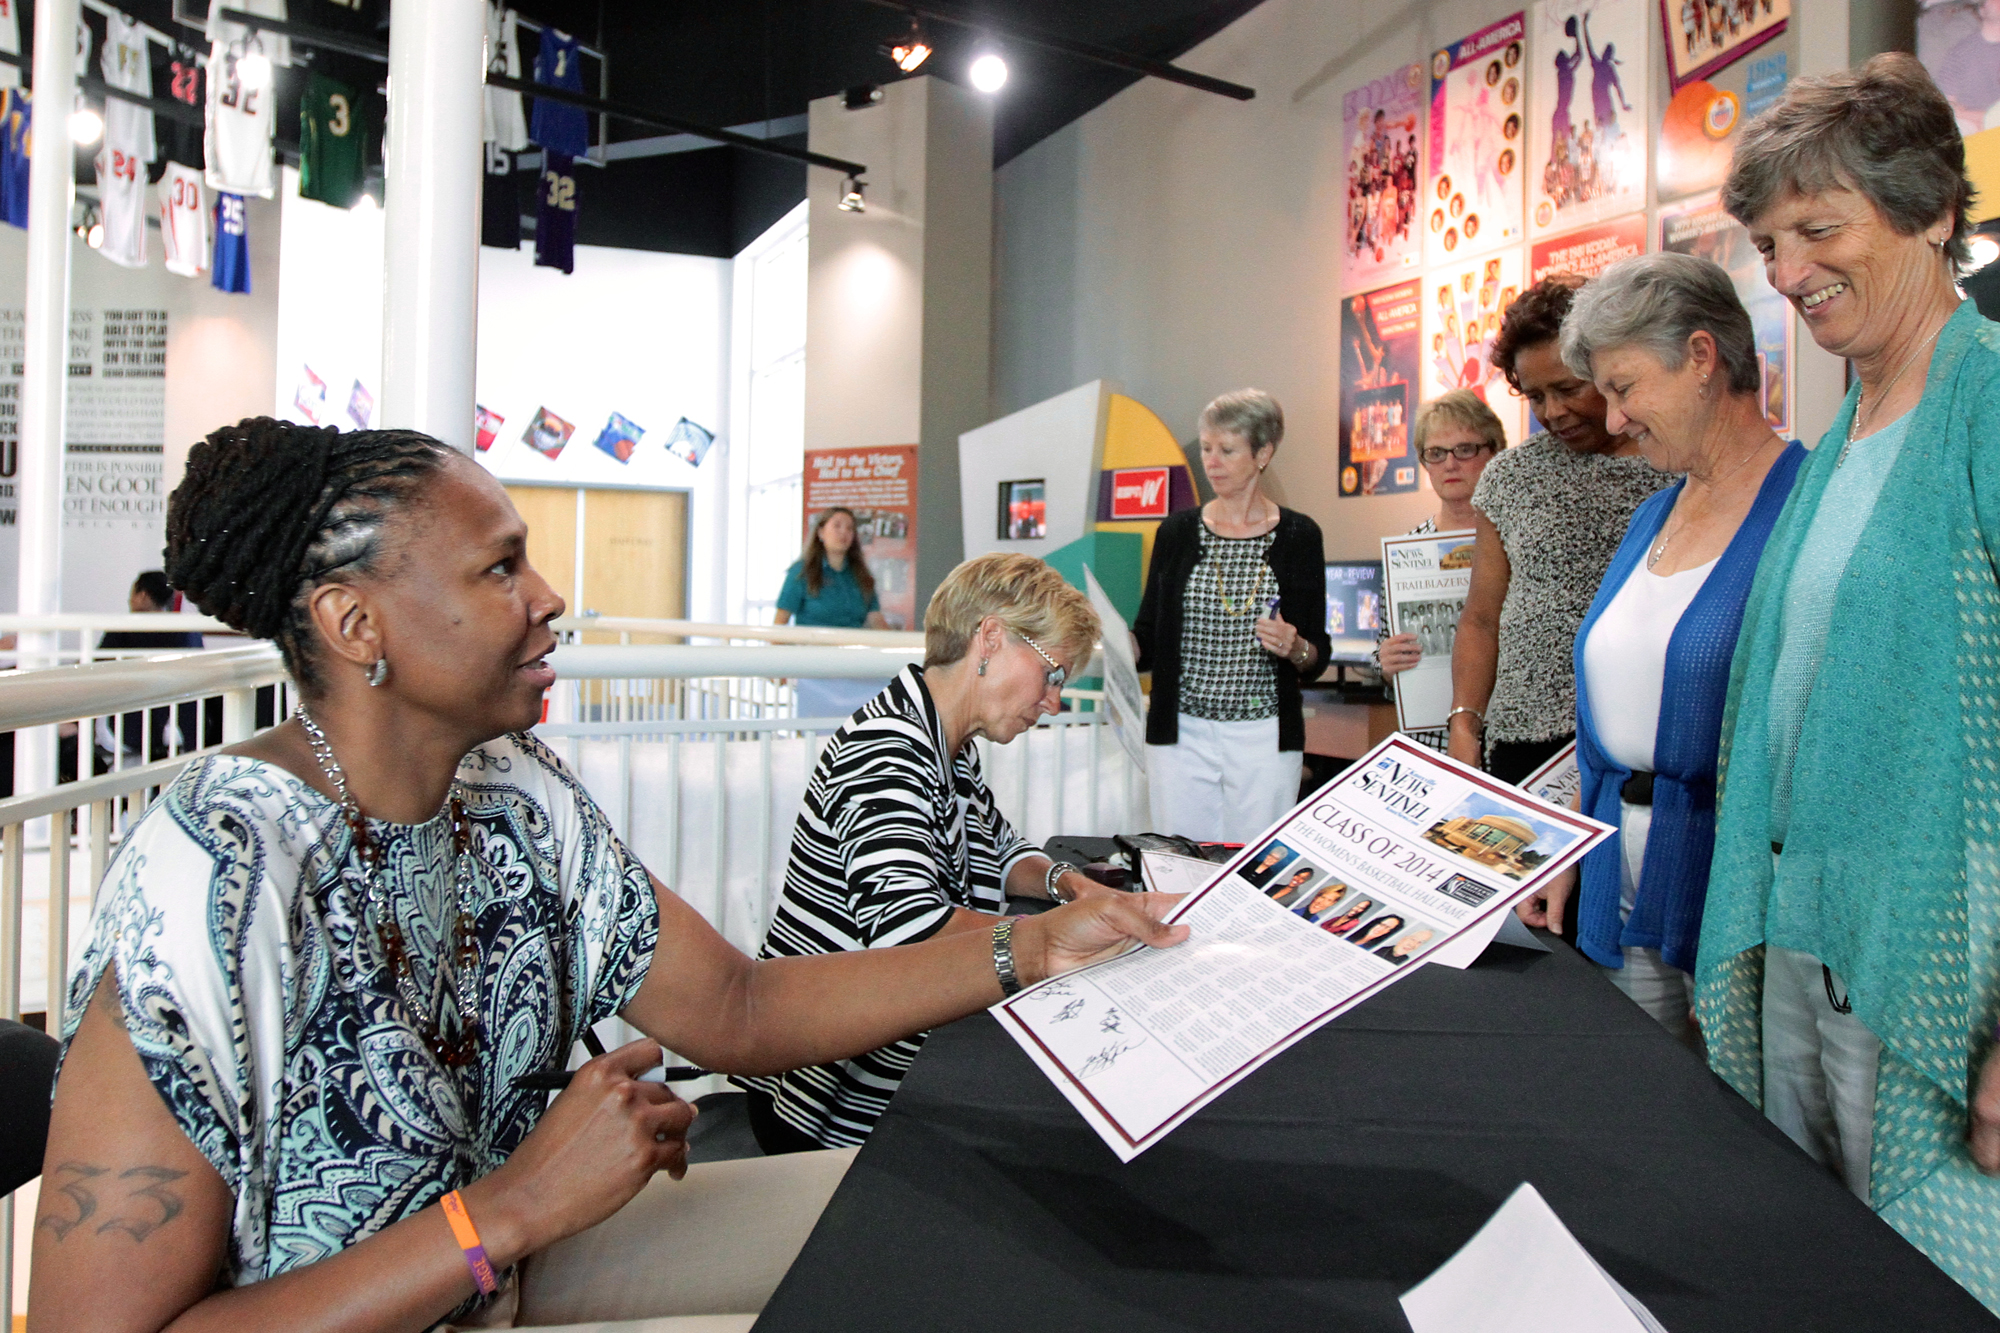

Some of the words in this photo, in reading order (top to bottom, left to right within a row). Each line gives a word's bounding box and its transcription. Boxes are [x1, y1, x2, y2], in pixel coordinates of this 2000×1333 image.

[1459, 20, 1522, 59] ALL-AMERICA
[329, 94, 350, 137] 3
[173, 177, 198, 211] 30
[546, 170, 576, 212] 32
[1549, 249, 1569, 264] THE
[1586, 236, 1619, 255] KODAK
[1391, 558, 1432, 570] SENTINEL
[1398, 549, 1424, 560] NEWS
[1348, 567, 1375, 580] REVIEW
[1395, 576, 1470, 591] TRAILBLAZERS
[1352, 771, 1430, 822] SENTINEL
[1379, 762, 1434, 798] NEWS
[1312, 804, 1373, 844] CLASS
[1367, 837, 1404, 859] OF
[1394, 851, 1447, 882] 2014
[1292, 819, 1314, 838] THE
[1313, 828, 1361, 868] WOMEN'S
[1356, 860, 1415, 896] BASKETBALL
[1411, 889, 1440, 907] HALL
[1436, 900, 1470, 919] FAME
[473, 1256, 496, 1291] RAGE
